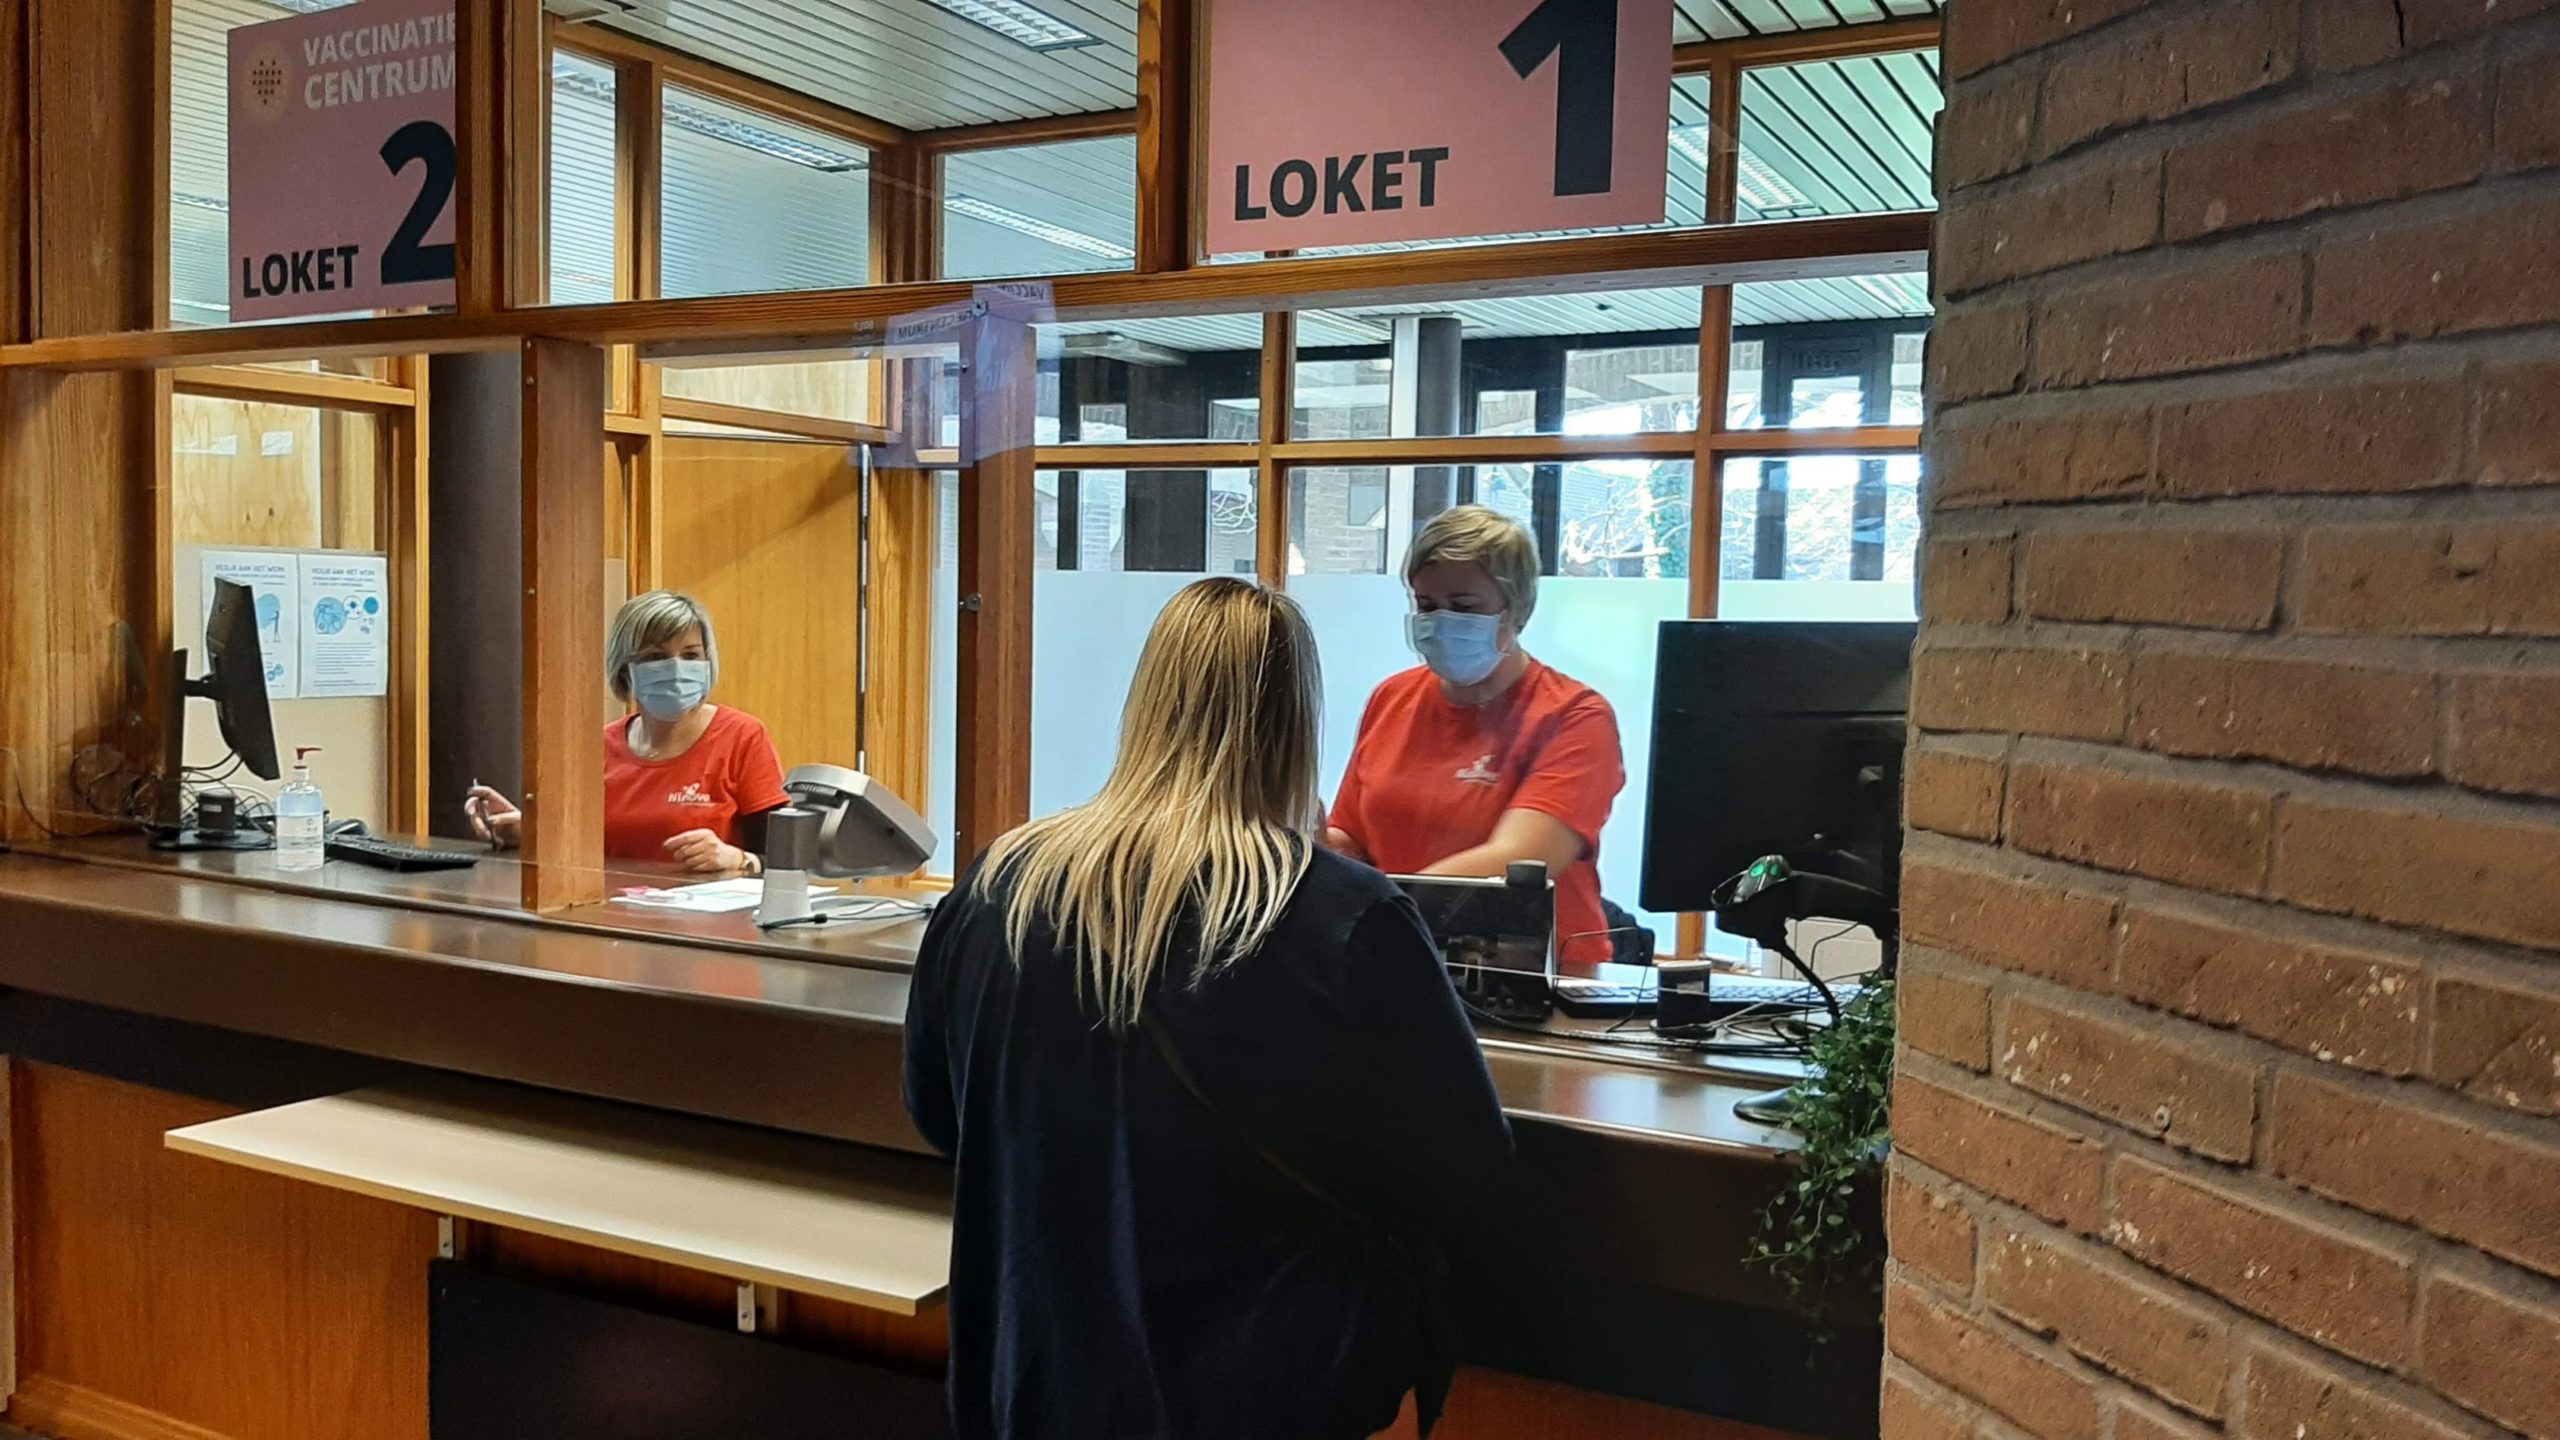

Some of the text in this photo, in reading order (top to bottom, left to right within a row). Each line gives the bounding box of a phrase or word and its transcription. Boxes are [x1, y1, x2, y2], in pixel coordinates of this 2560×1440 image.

[304, 51, 456, 110] CENTRUM
[1235, 0, 1617, 220] LOKET 1
[243, 121, 456, 298] LOKET 2
